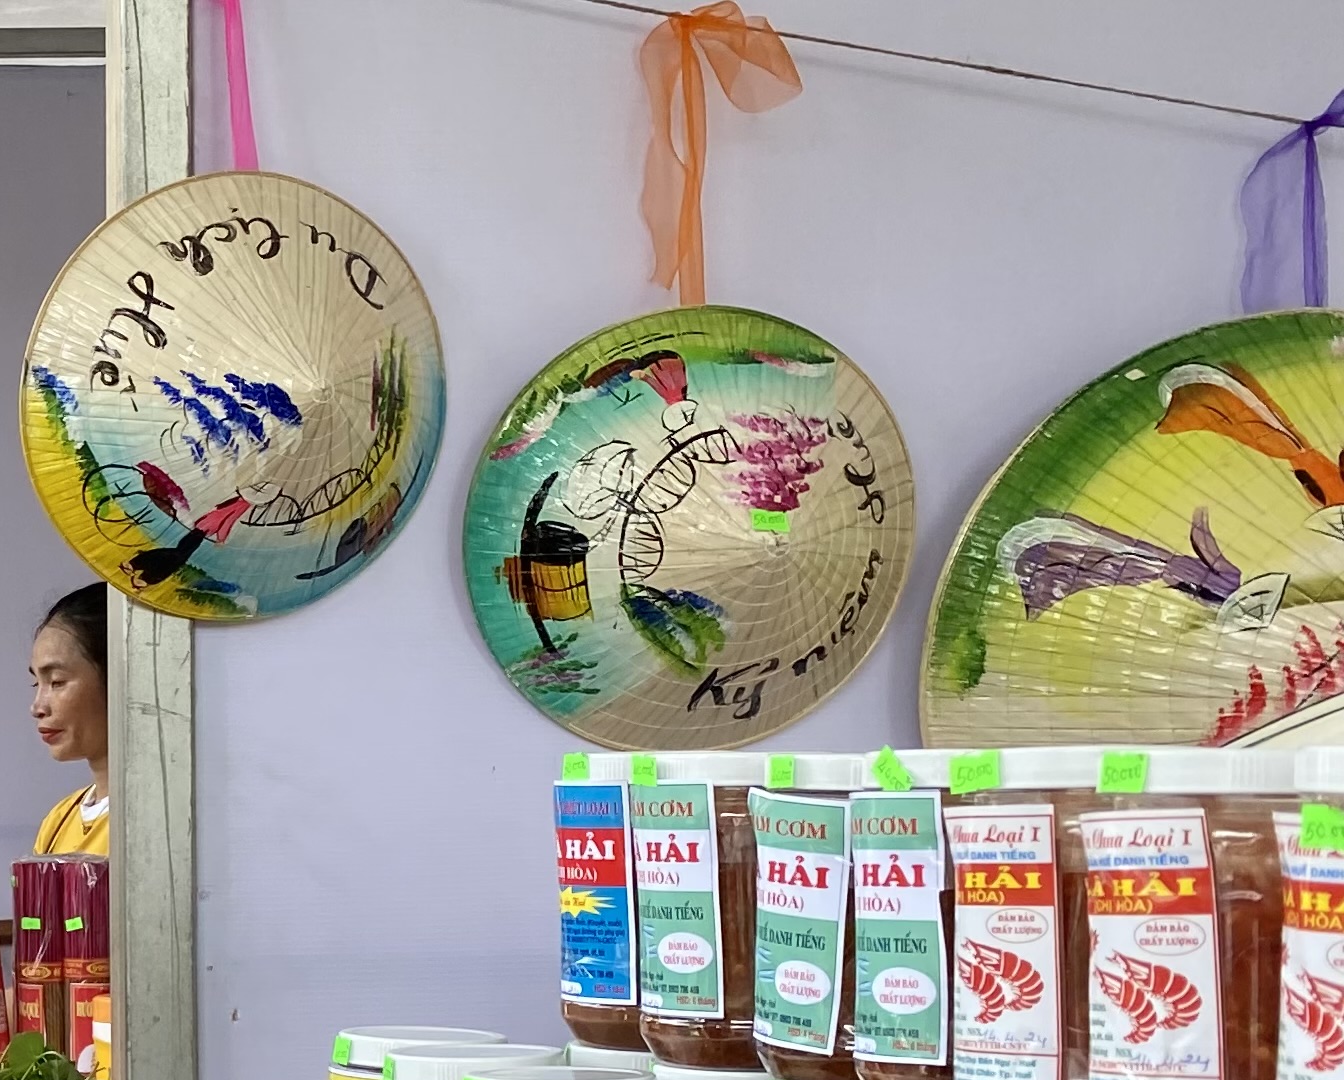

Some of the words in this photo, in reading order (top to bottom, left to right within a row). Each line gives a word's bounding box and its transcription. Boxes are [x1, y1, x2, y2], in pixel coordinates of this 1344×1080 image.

[649, 800, 694, 817] CƠM
[776, 818, 828, 840] CƠM
[868, 815, 919, 835] CƠM
[983, 824, 1025, 848] Loại
[565, 832, 616, 860] HẢI
[646, 833, 700, 863] HẢI
[1128, 826, 1174, 852] Loại
[862, 854, 926, 887] HẢI
[1148, 853, 1190, 866] TIẾNG
[768, 855, 830, 888] HẢI
[964, 865, 1042, 889] HẢI
[1112, 871, 1197, 897] HẢI
[768, 888, 805, 911] HÒA)
[863, 893, 901, 914] HÒA)
[967, 888, 1005, 905] HÒA)
[1116, 897, 1153, 914] HÒA)
[674, 900, 703, 920] TIẾNG
[769, 929, 792, 946] DANH
[796, 928, 825, 951] TIẾNG
[867, 936, 890, 953] DANH
[893, 931, 927, 954] TIẾNG
